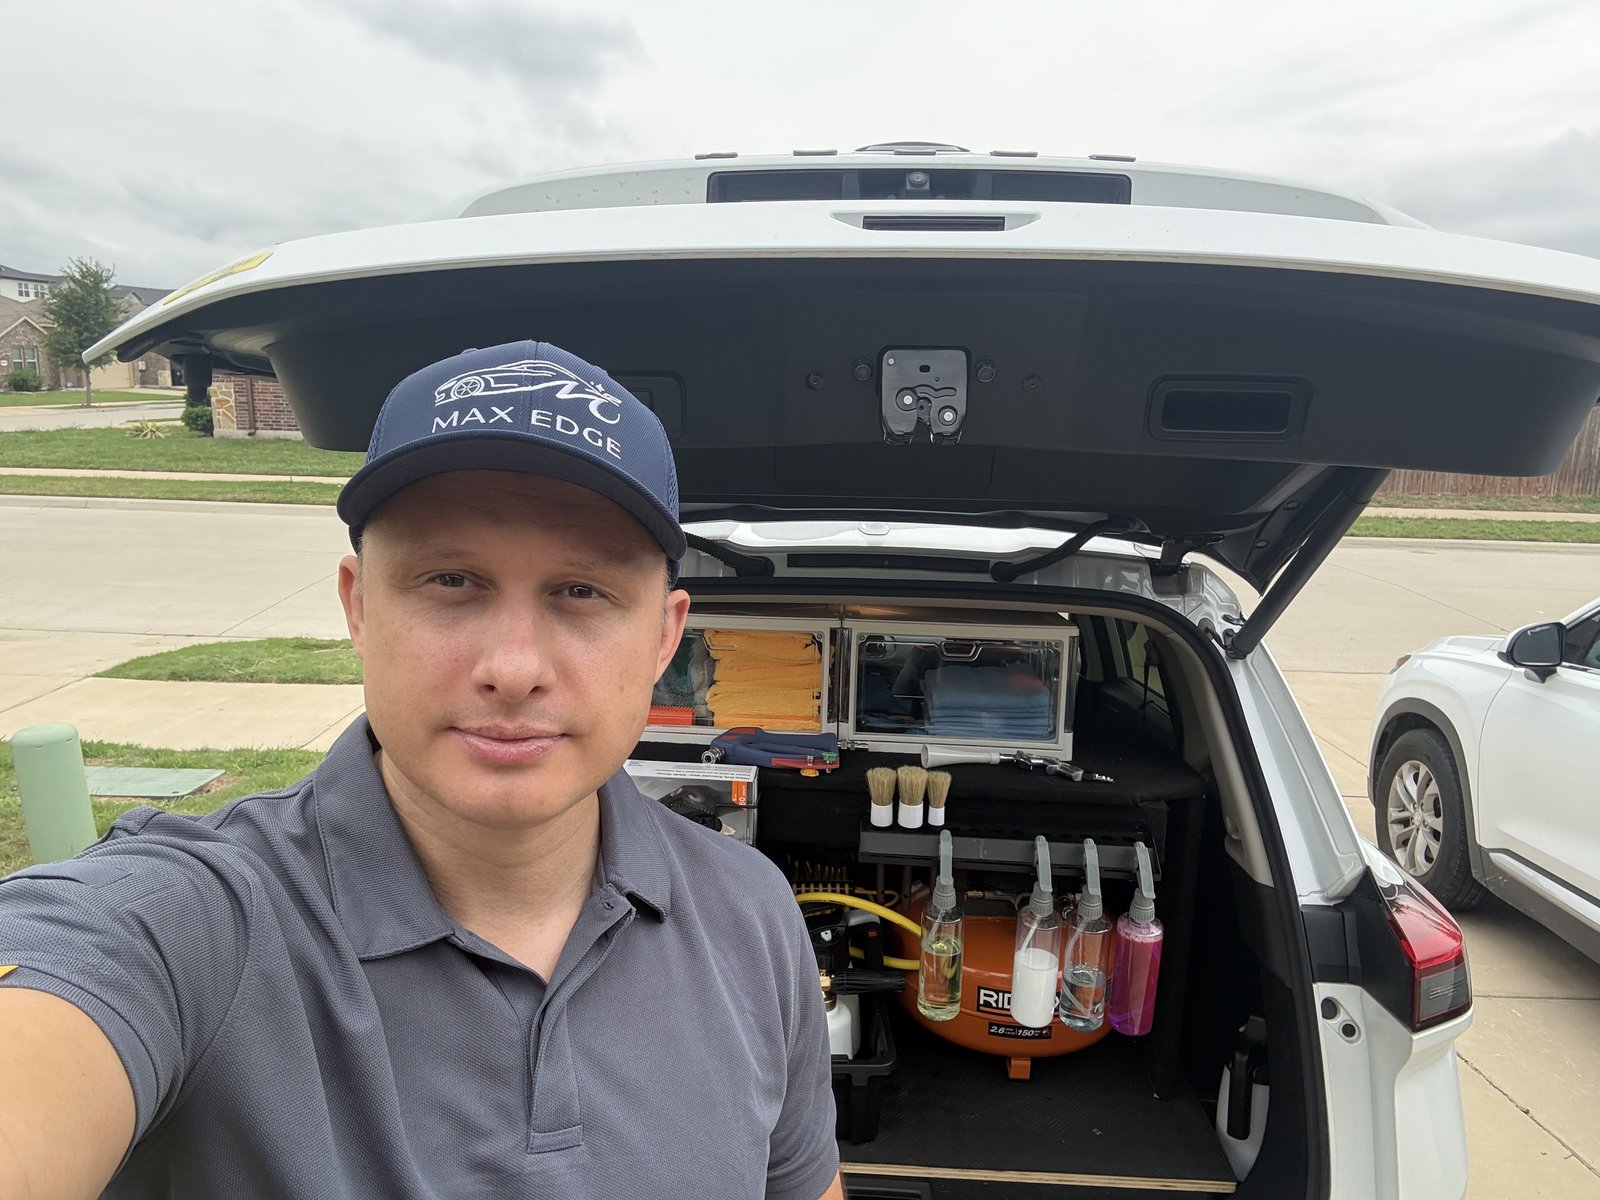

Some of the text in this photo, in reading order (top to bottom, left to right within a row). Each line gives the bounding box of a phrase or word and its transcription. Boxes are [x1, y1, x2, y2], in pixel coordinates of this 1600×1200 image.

[432, 406, 622, 460] MAX EDGE
[989, 1025, 1006, 1034] 2.6
[1017, 1029, 1034, 1037] 150
